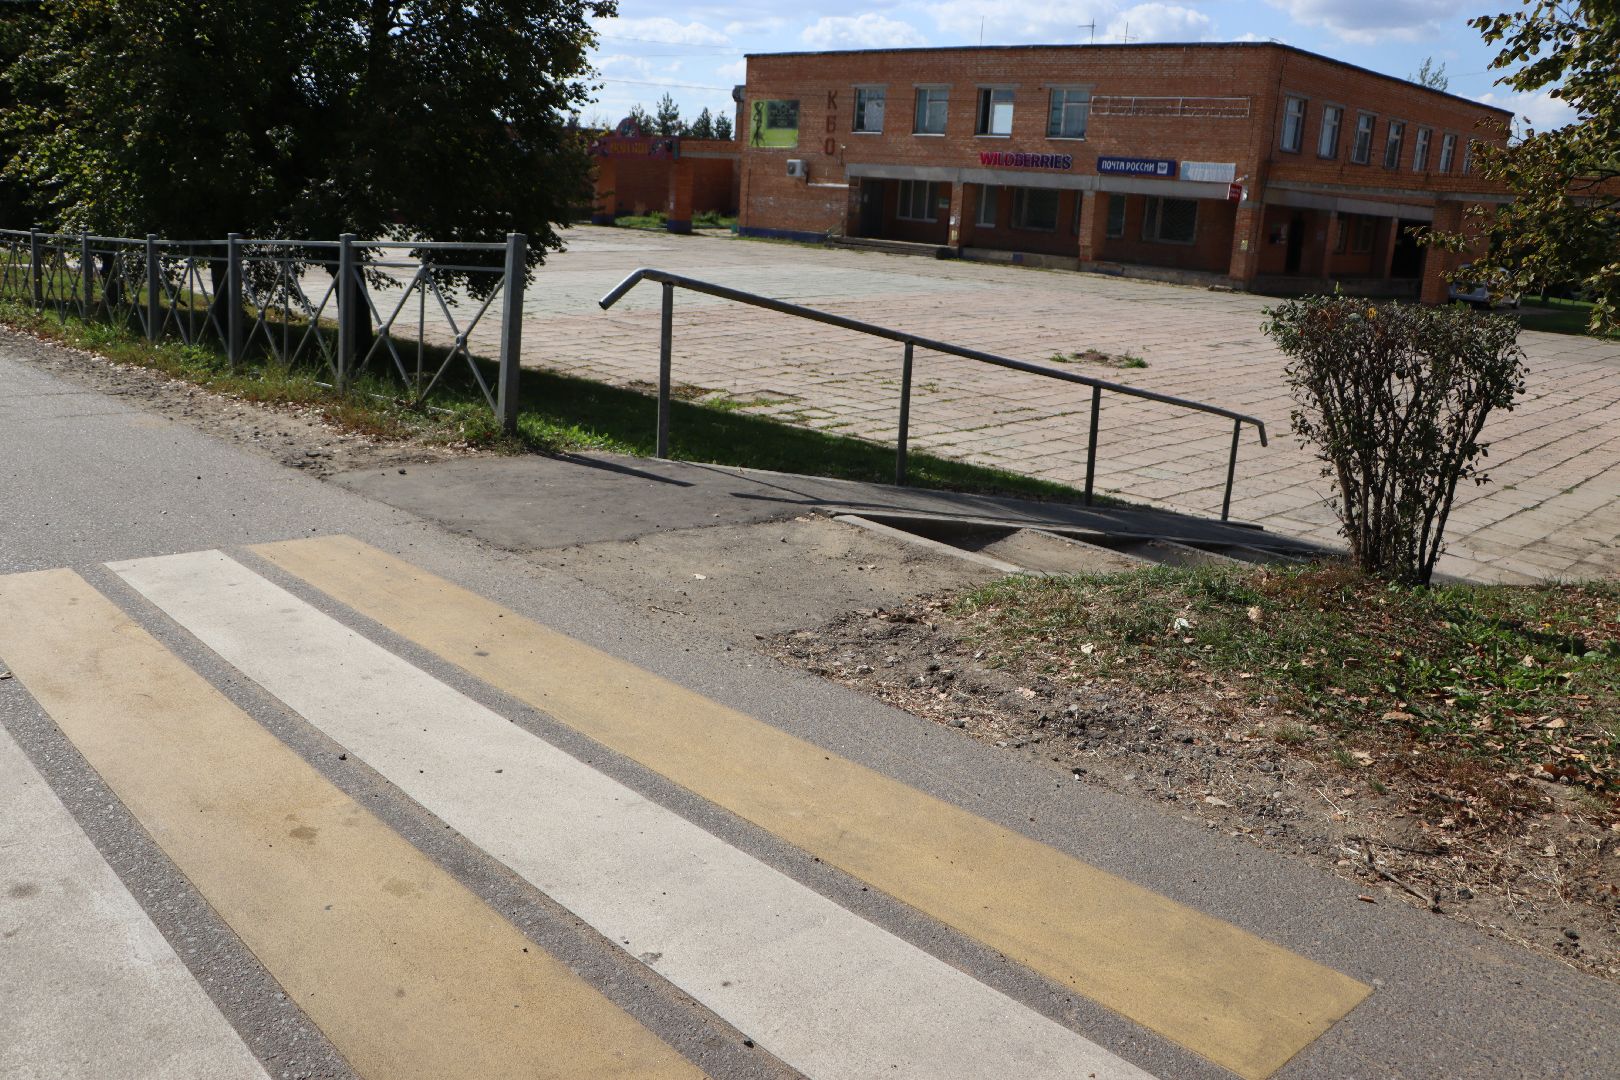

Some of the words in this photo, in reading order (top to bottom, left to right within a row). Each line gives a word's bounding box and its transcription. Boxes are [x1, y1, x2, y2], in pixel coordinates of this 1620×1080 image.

[980, 151, 1073, 170] WILDBERRIES
[1101, 160, 1125, 171] ПОЧТА
[1126, 161, 1155, 172] РОССИИ
